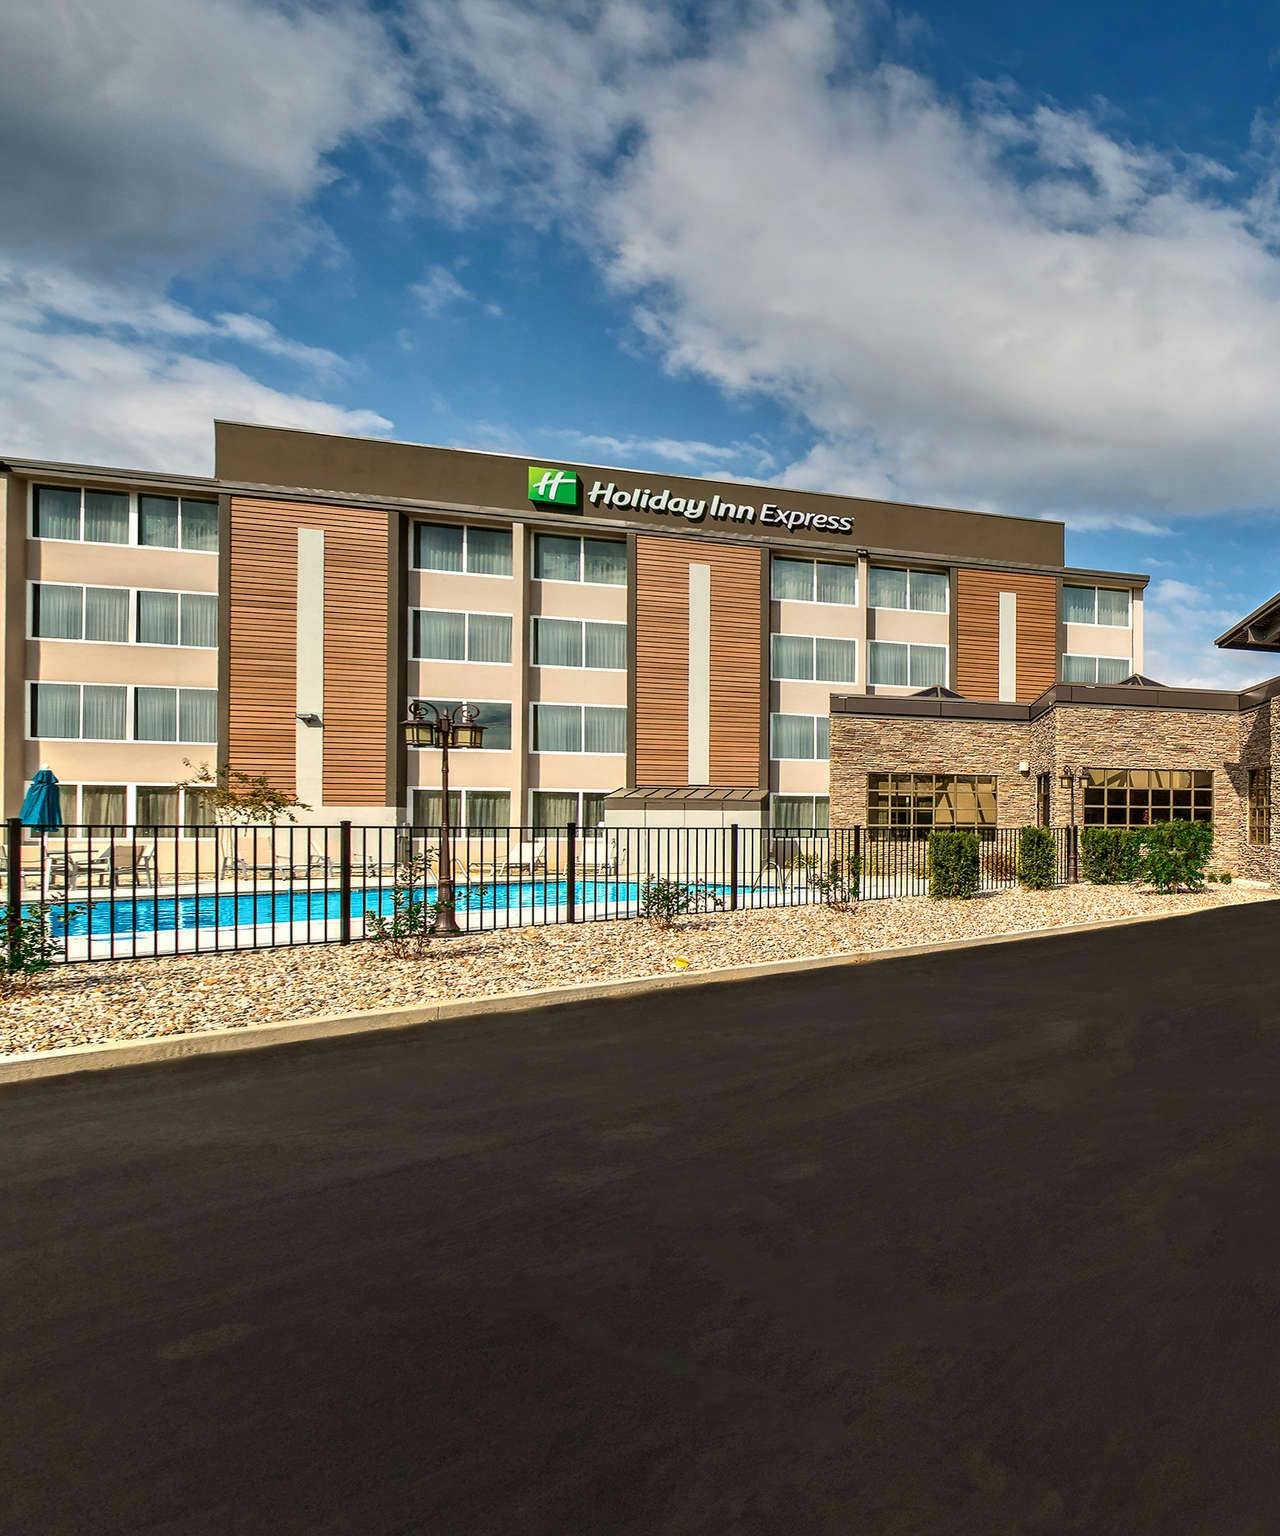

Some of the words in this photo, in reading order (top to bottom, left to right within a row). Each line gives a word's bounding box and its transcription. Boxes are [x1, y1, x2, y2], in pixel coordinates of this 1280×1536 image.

[587, 481, 706, 519] Holiday
[709, 494, 755, 521] Inn
[760, 503, 853, 531] Express
